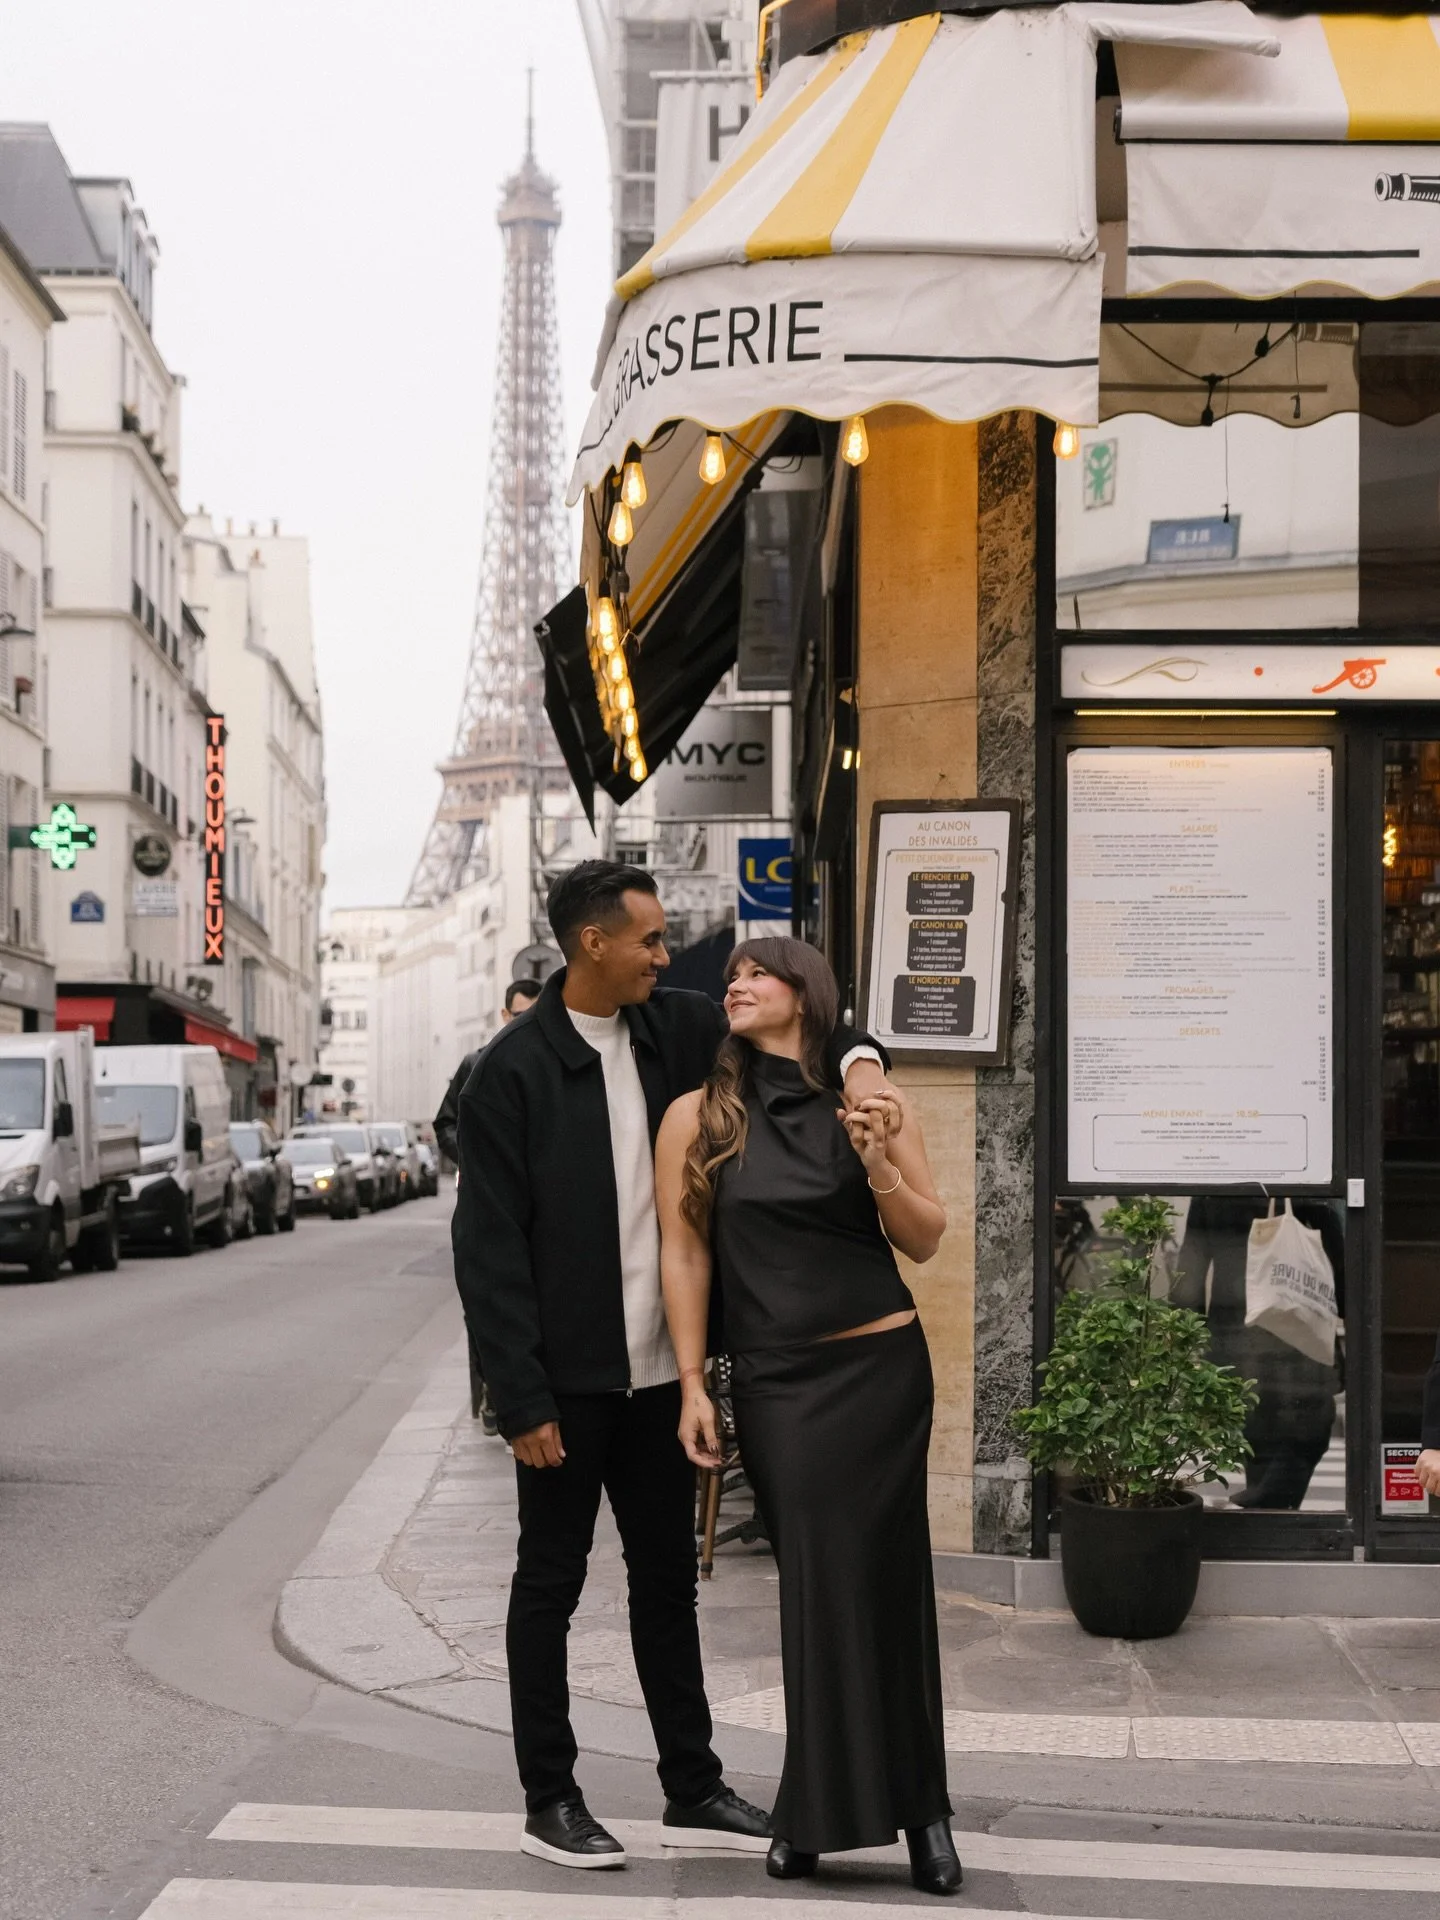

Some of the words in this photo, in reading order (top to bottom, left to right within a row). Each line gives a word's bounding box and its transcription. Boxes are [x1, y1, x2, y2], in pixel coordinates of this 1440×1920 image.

[613, 301, 824, 418] BRASSERIE
[667, 742, 766, 765] MYC
[684, 774, 747, 783] BOUTIQUE
[917, 821, 931, 832] AU
[933, 820, 972, 832] CANON
[1181, 824, 1218, 833] SALADES
[206, 718, 225, 958] THOUMIEUX
[908, 836, 927, 847] DES
[928, 835, 978, 847] INVALIDES
[912, 873, 920, 881] LE
[920, 873, 952, 881] FRENCHIE
[1169, 885, 1195, 894] PLATS
[912, 921, 920, 929] LE
[920, 921, 946, 929] CANON
[908, 976, 916, 984] LE
[916, 976, 942, 985] NORDIC
[1164, 986, 1214, 994] FROMAGES
[1179, 1027, 1221, 1036] DESSERTS
[1142, 1110, 1168, 1118] MENU
[1170, 1110, 1204, 1118] ENFANT
[1387, 1449, 1421, 1457] SECTOR
